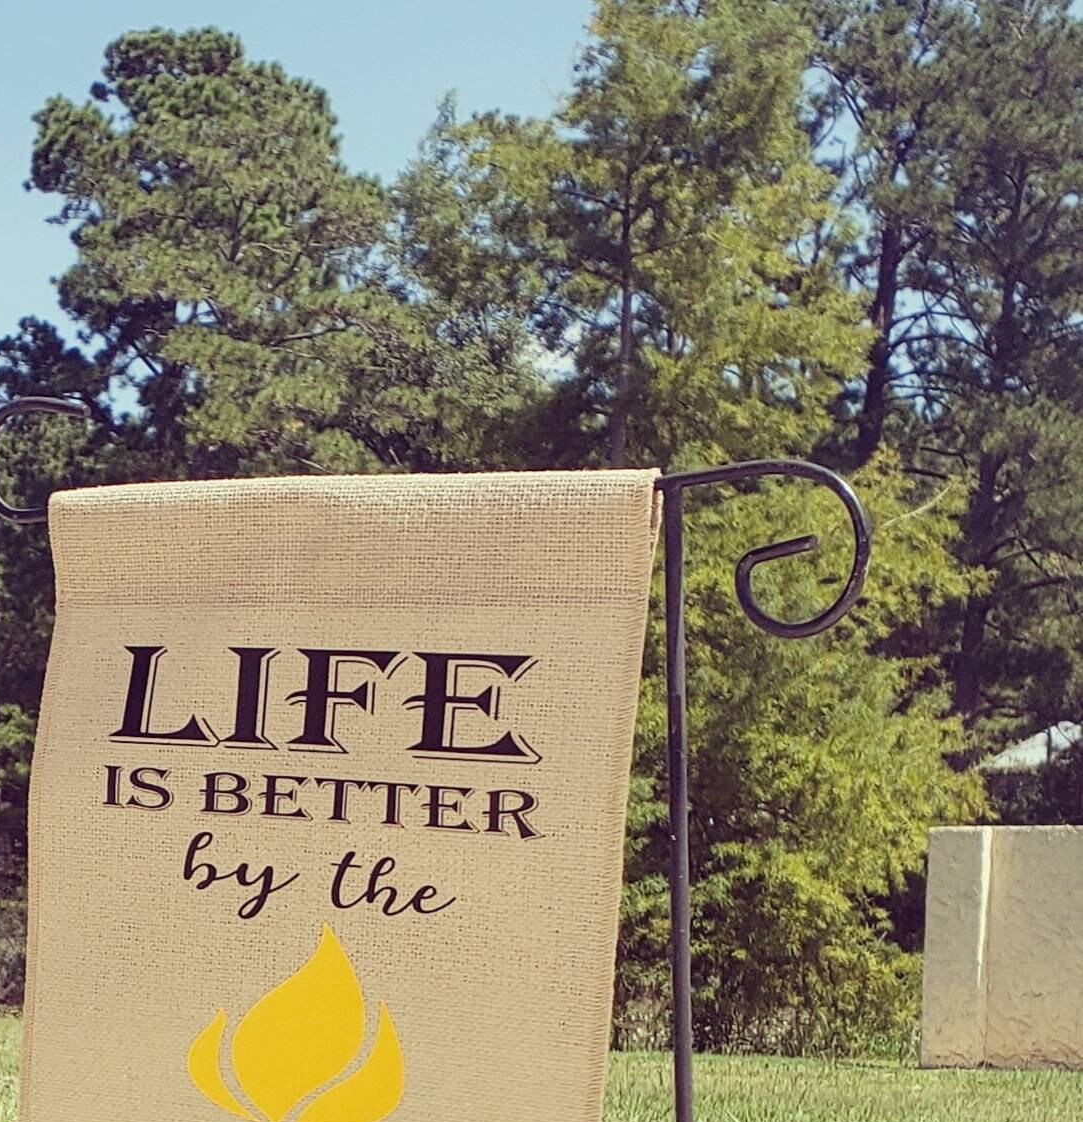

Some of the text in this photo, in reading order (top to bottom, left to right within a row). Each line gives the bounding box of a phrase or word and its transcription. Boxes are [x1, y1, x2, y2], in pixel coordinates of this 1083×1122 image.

[109, 645, 544, 764] LIFE
[103, 765, 544, 841] IS BETTER
[183, 831, 457, 920] by the
